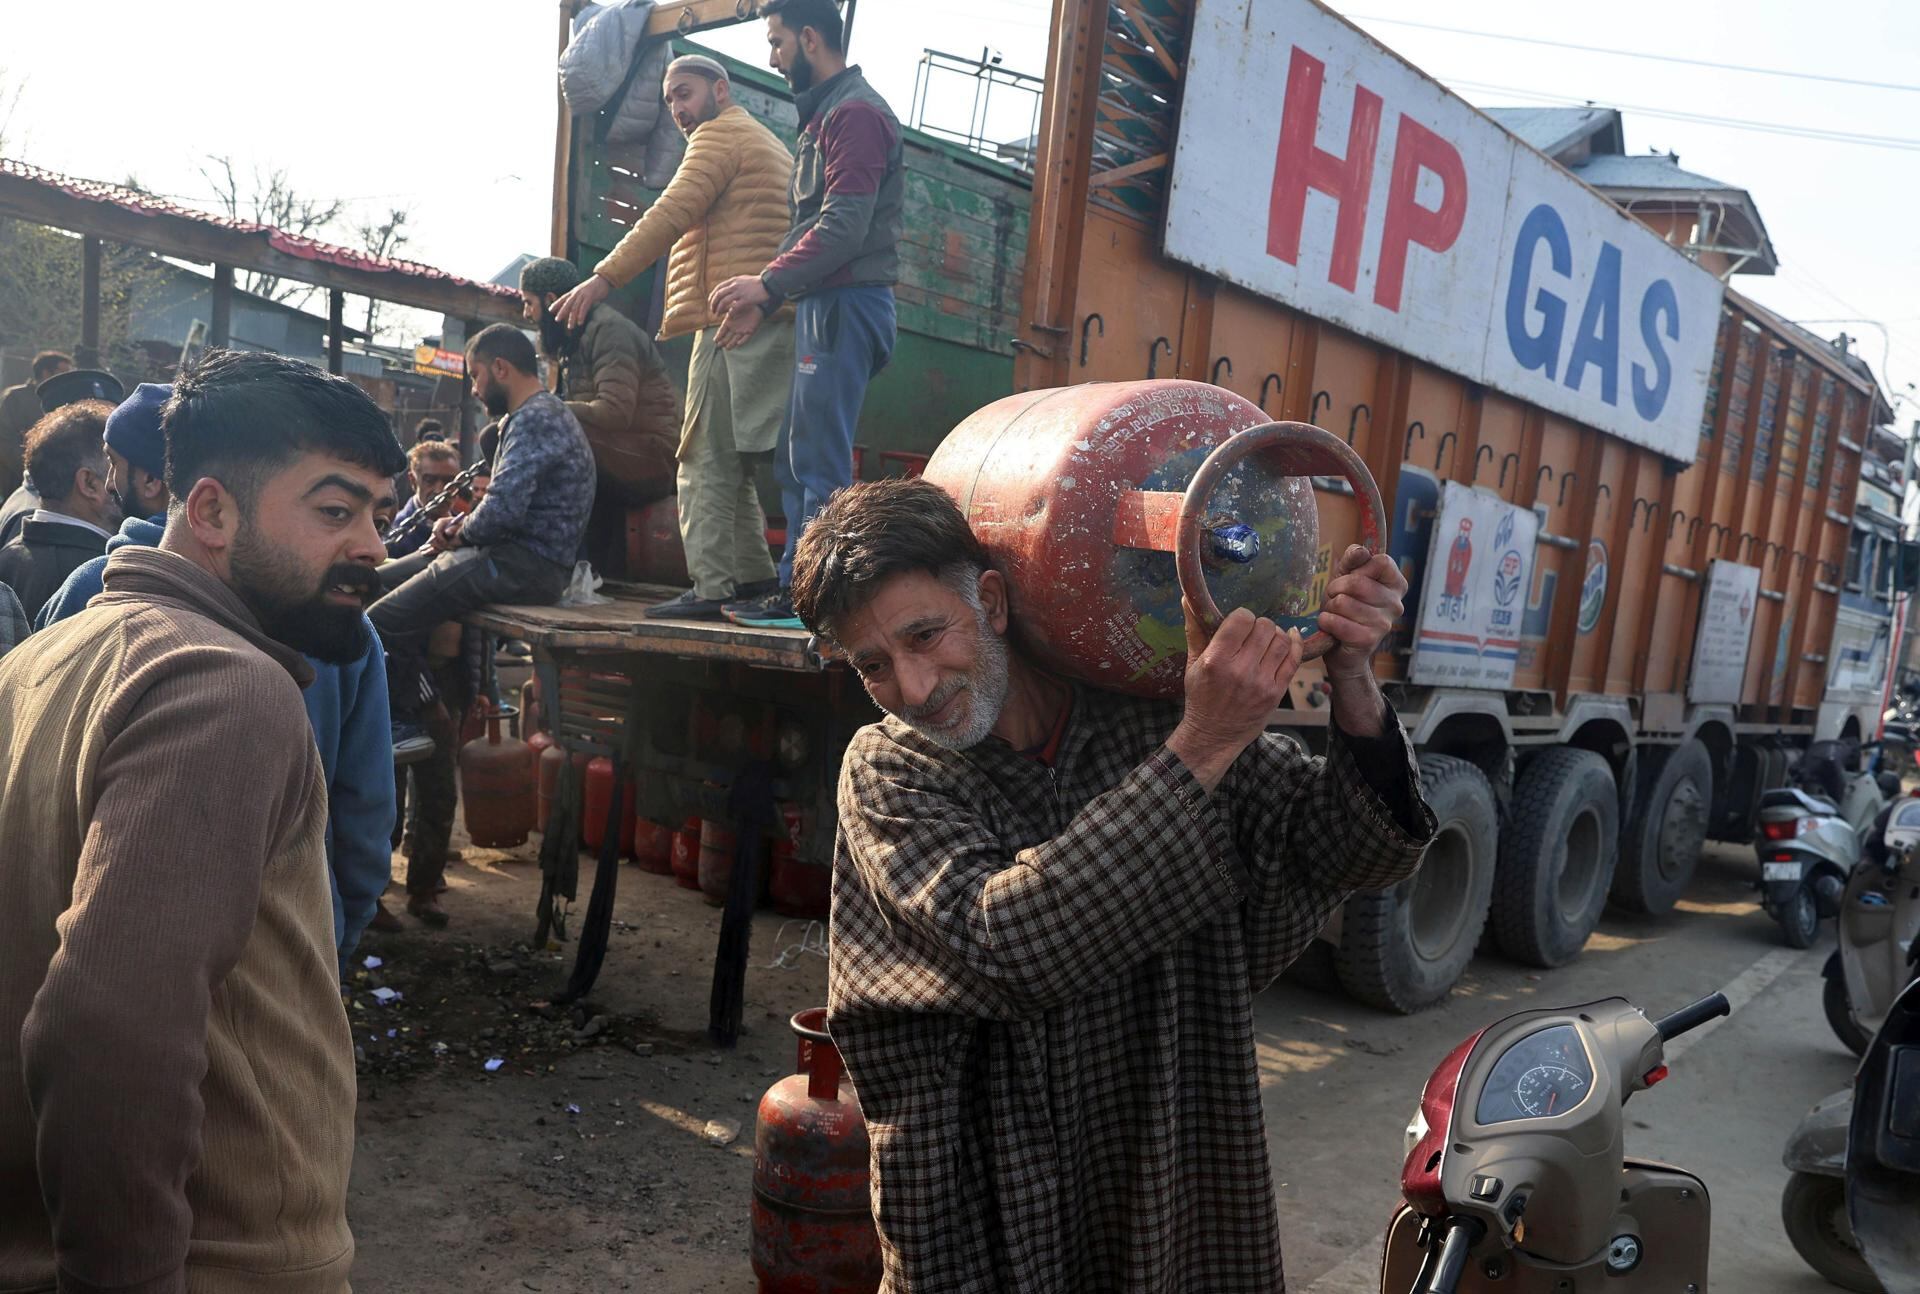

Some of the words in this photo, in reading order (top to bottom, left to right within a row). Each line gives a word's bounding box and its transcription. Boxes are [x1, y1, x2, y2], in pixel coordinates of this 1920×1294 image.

[1266, 44, 1468, 314] HP
[1505, 203, 1680, 423] GAS
[1133, 387, 1193, 409] DOMESTIC
[1196, 389, 1220, 401] FOR
[1104, 618, 1125, 641] CHECK
[1121, 639, 1137, 656] SEAL
[1106, 634, 1118, 646] ON
